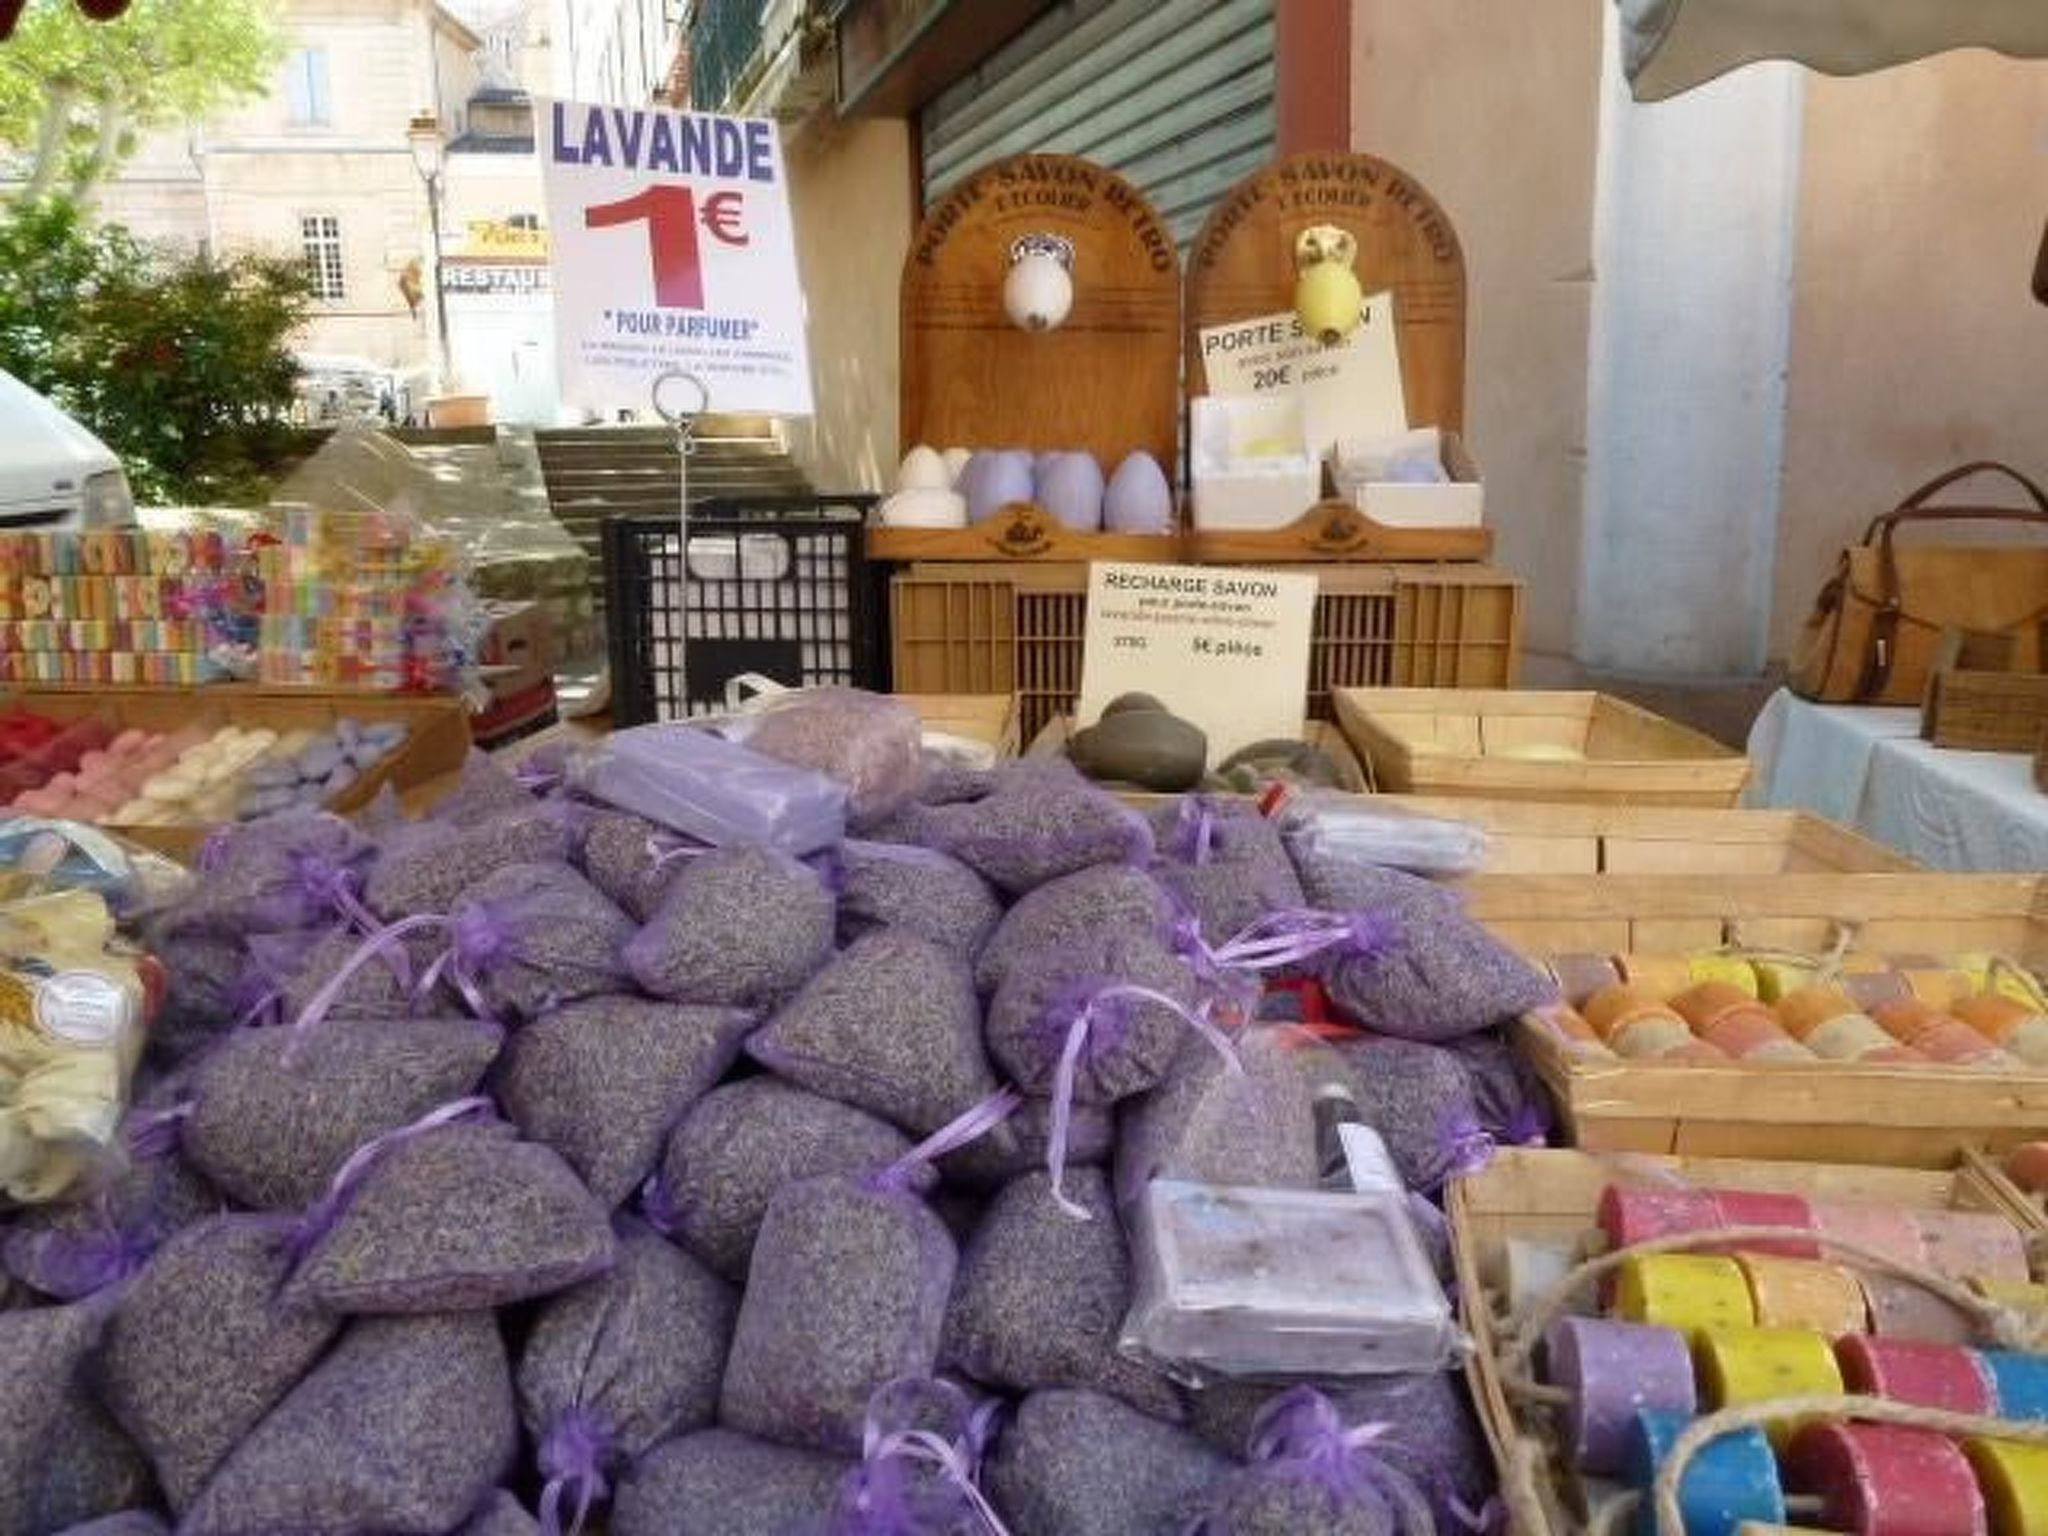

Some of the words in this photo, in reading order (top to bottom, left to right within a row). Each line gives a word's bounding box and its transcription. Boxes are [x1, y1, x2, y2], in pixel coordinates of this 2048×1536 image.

[553, 103, 774, 182] LAVANDE
[616, 311, 662, 336] POUR
[1206, 321, 1284, 355] PORTE
[1254, 364, 1291, 390] 20€
[1104, 572, 1207, 594] RECHARGE
[1212, 580, 1278, 598] SAVON
